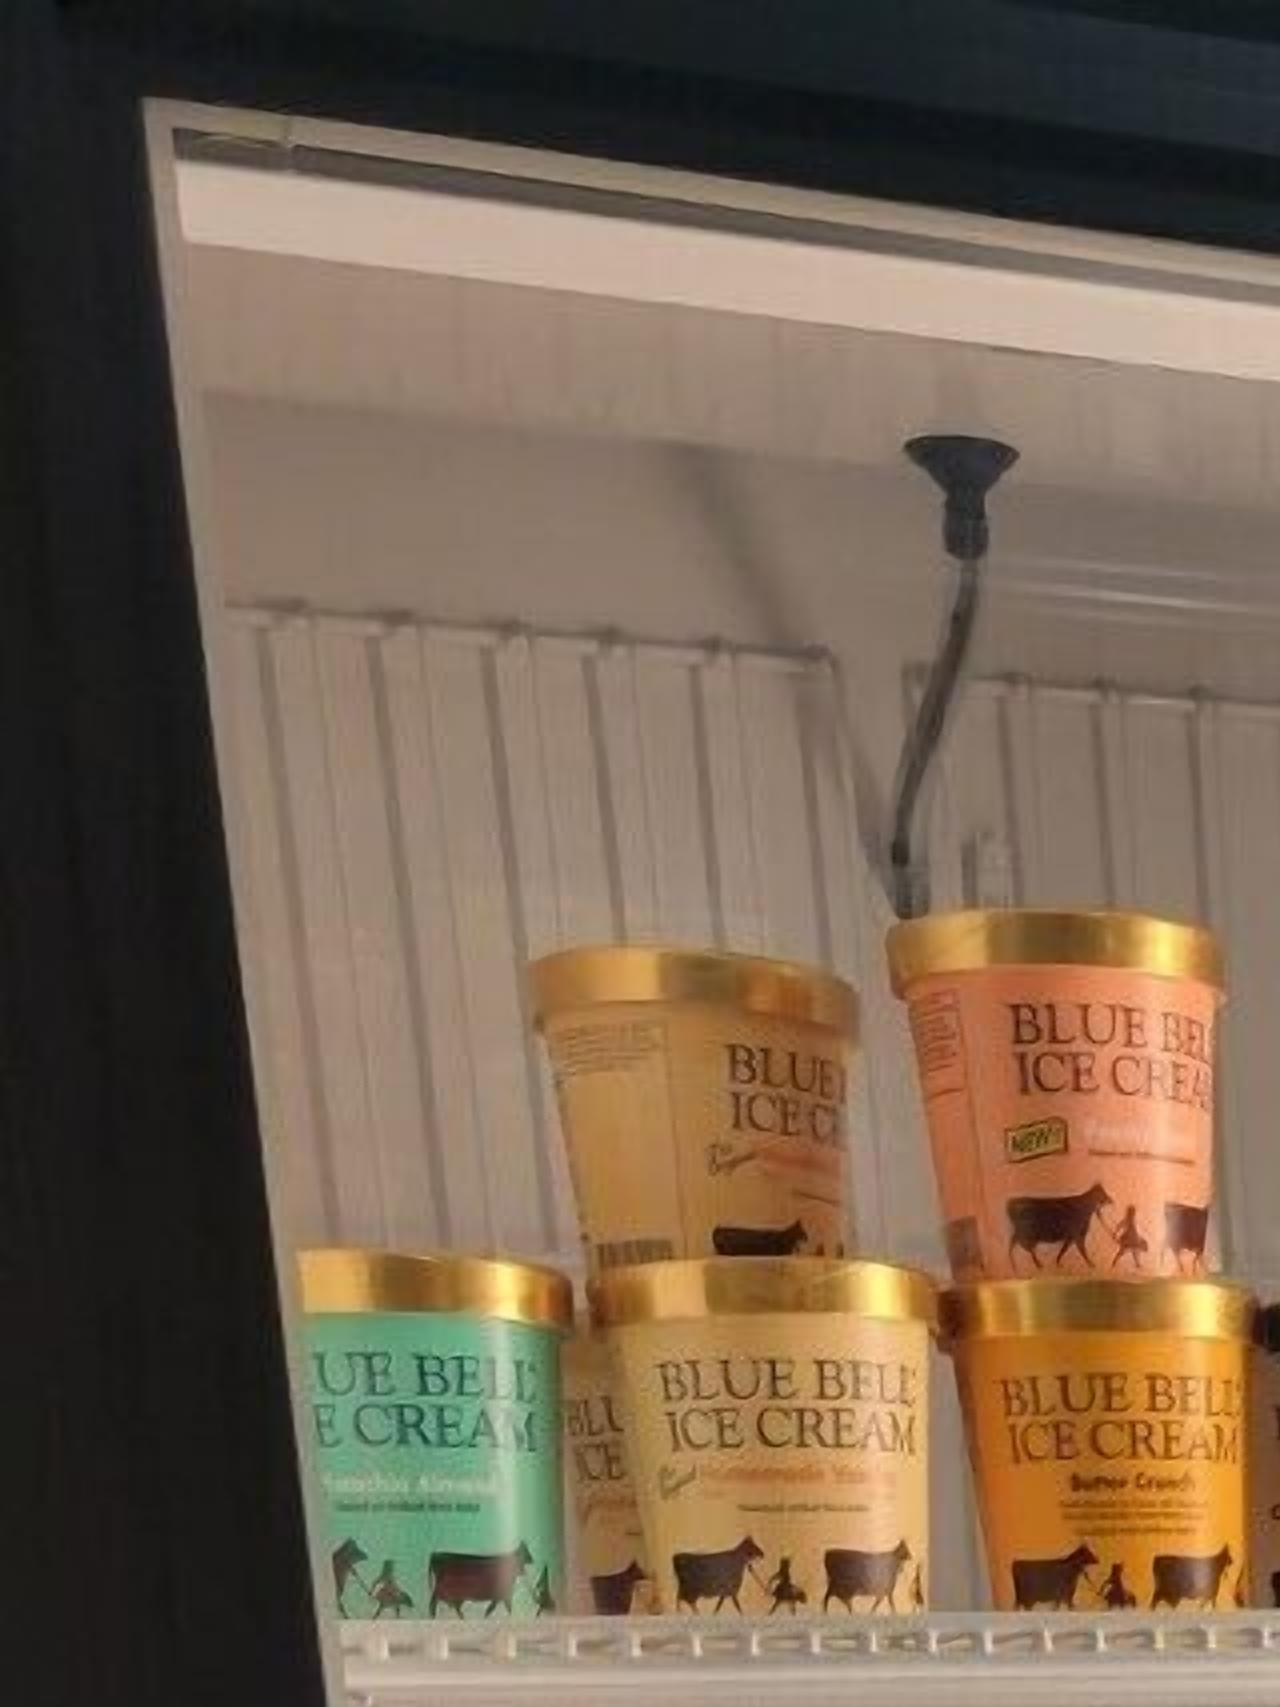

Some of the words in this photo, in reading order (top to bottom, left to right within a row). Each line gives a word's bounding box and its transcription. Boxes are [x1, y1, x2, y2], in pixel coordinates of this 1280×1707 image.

[1009, 1003, 1147, 1047] BLUE
[724, 1042, 835, 1098] BLUE
[1016, 1053, 1099, 1095] ICE
[1112, 1056, 1210, 1109] CREA
[732, 1092, 801, 1135] ICE
[312, 1351, 396, 1396] UE
[653, 1358, 799, 1400] BLUE
[993, 1371, 1128, 1416] BLUE
[664, 1408, 743, 1451] ICE
[757, 1407, 917, 1455] CREAM
[1007, 1421, 1081, 1464] ICE
[1090, 1420, 1238, 1464] CREAM
